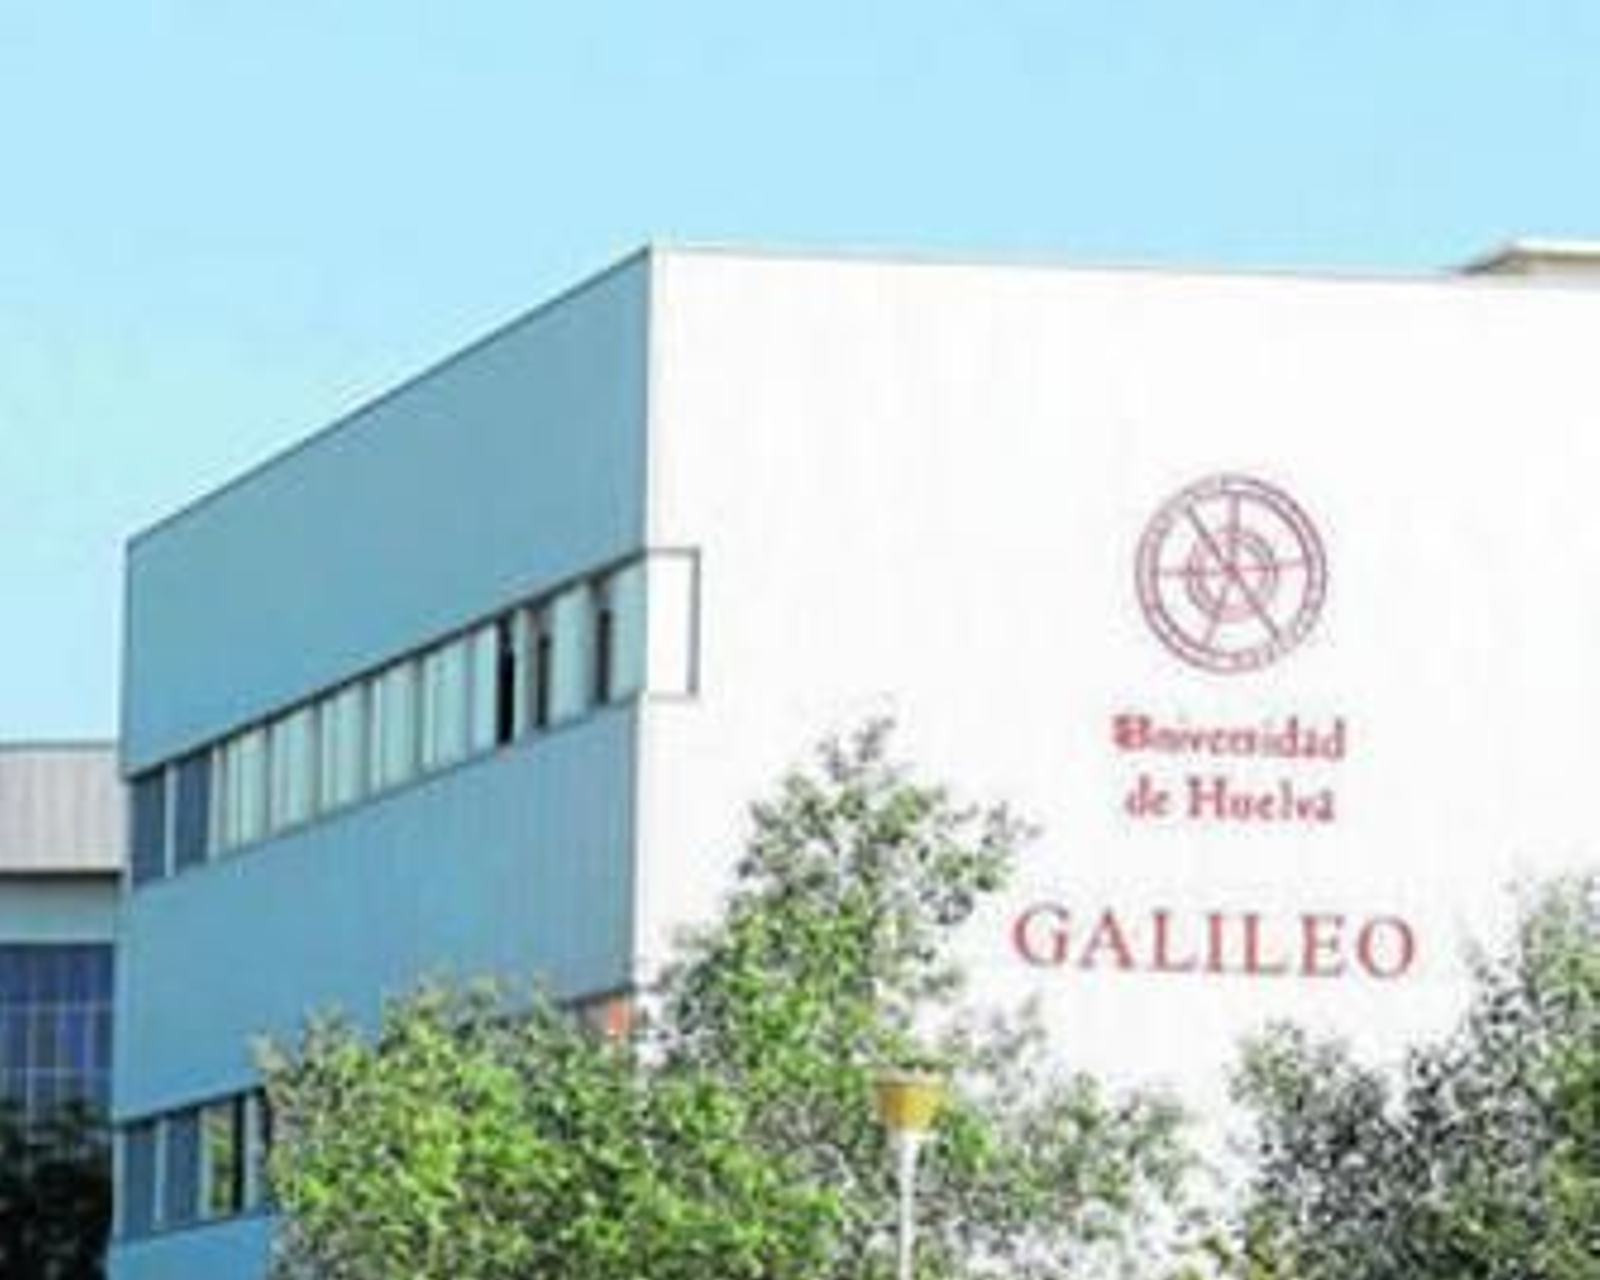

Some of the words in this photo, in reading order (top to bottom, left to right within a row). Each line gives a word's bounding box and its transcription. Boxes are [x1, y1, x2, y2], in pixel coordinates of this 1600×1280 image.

[1111, 713, 1346, 760] Universidad
[1124, 774, 1170, 818] de
[1186, 776, 1335, 822] Huelva
[1012, 903, 1416, 980] GALILEO
